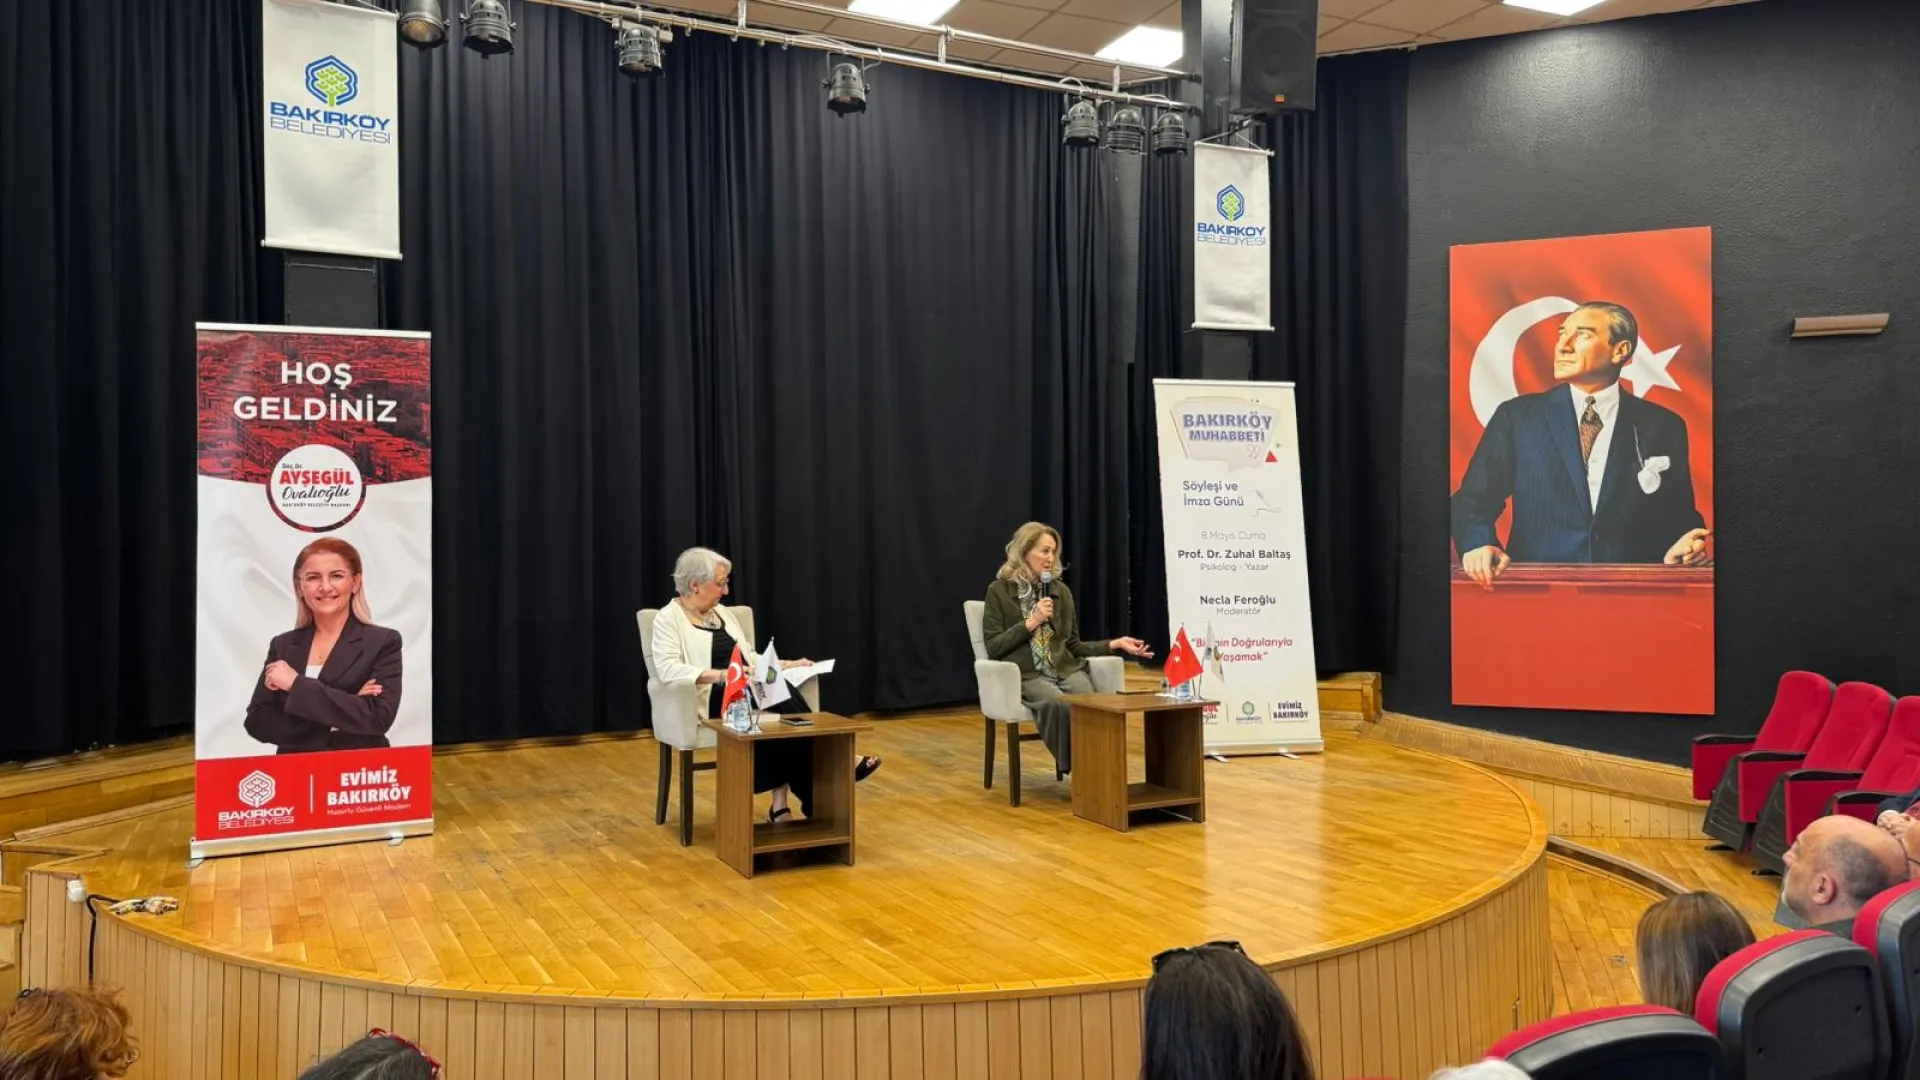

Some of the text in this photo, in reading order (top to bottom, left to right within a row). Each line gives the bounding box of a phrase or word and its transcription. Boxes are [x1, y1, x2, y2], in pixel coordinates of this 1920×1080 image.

[281, 361, 353, 390] HOŞ
[233, 393, 397, 423] GELDİNİZ
[1183, 411, 1272, 430] BAKIRKÖY
[1189, 428, 1265, 443] MUHABBETİ
[279, 468, 354, 487] AYŞEGÜL
[1183, 480, 1238, 493] Söyleşi ve
[1183, 493, 1244, 506] İmza Günü
[1238, 531, 1266, 540] Cuma
[1178, 550, 1291, 560] Prof. Dr. Zuhal Baltaş
[1200, 563, 1237, 572] Psikolog
[1245, 563, 1269, 571] Yazar
[1200, 594, 1276, 606] Necla Feroğlu
[1216, 607, 1261, 615] Moderatör
[1231, 637, 1293, 648] Doğrularıyla
[340, 765, 398, 787] EVİMİZ
[327, 783, 412, 806] BAKIRKÖY
